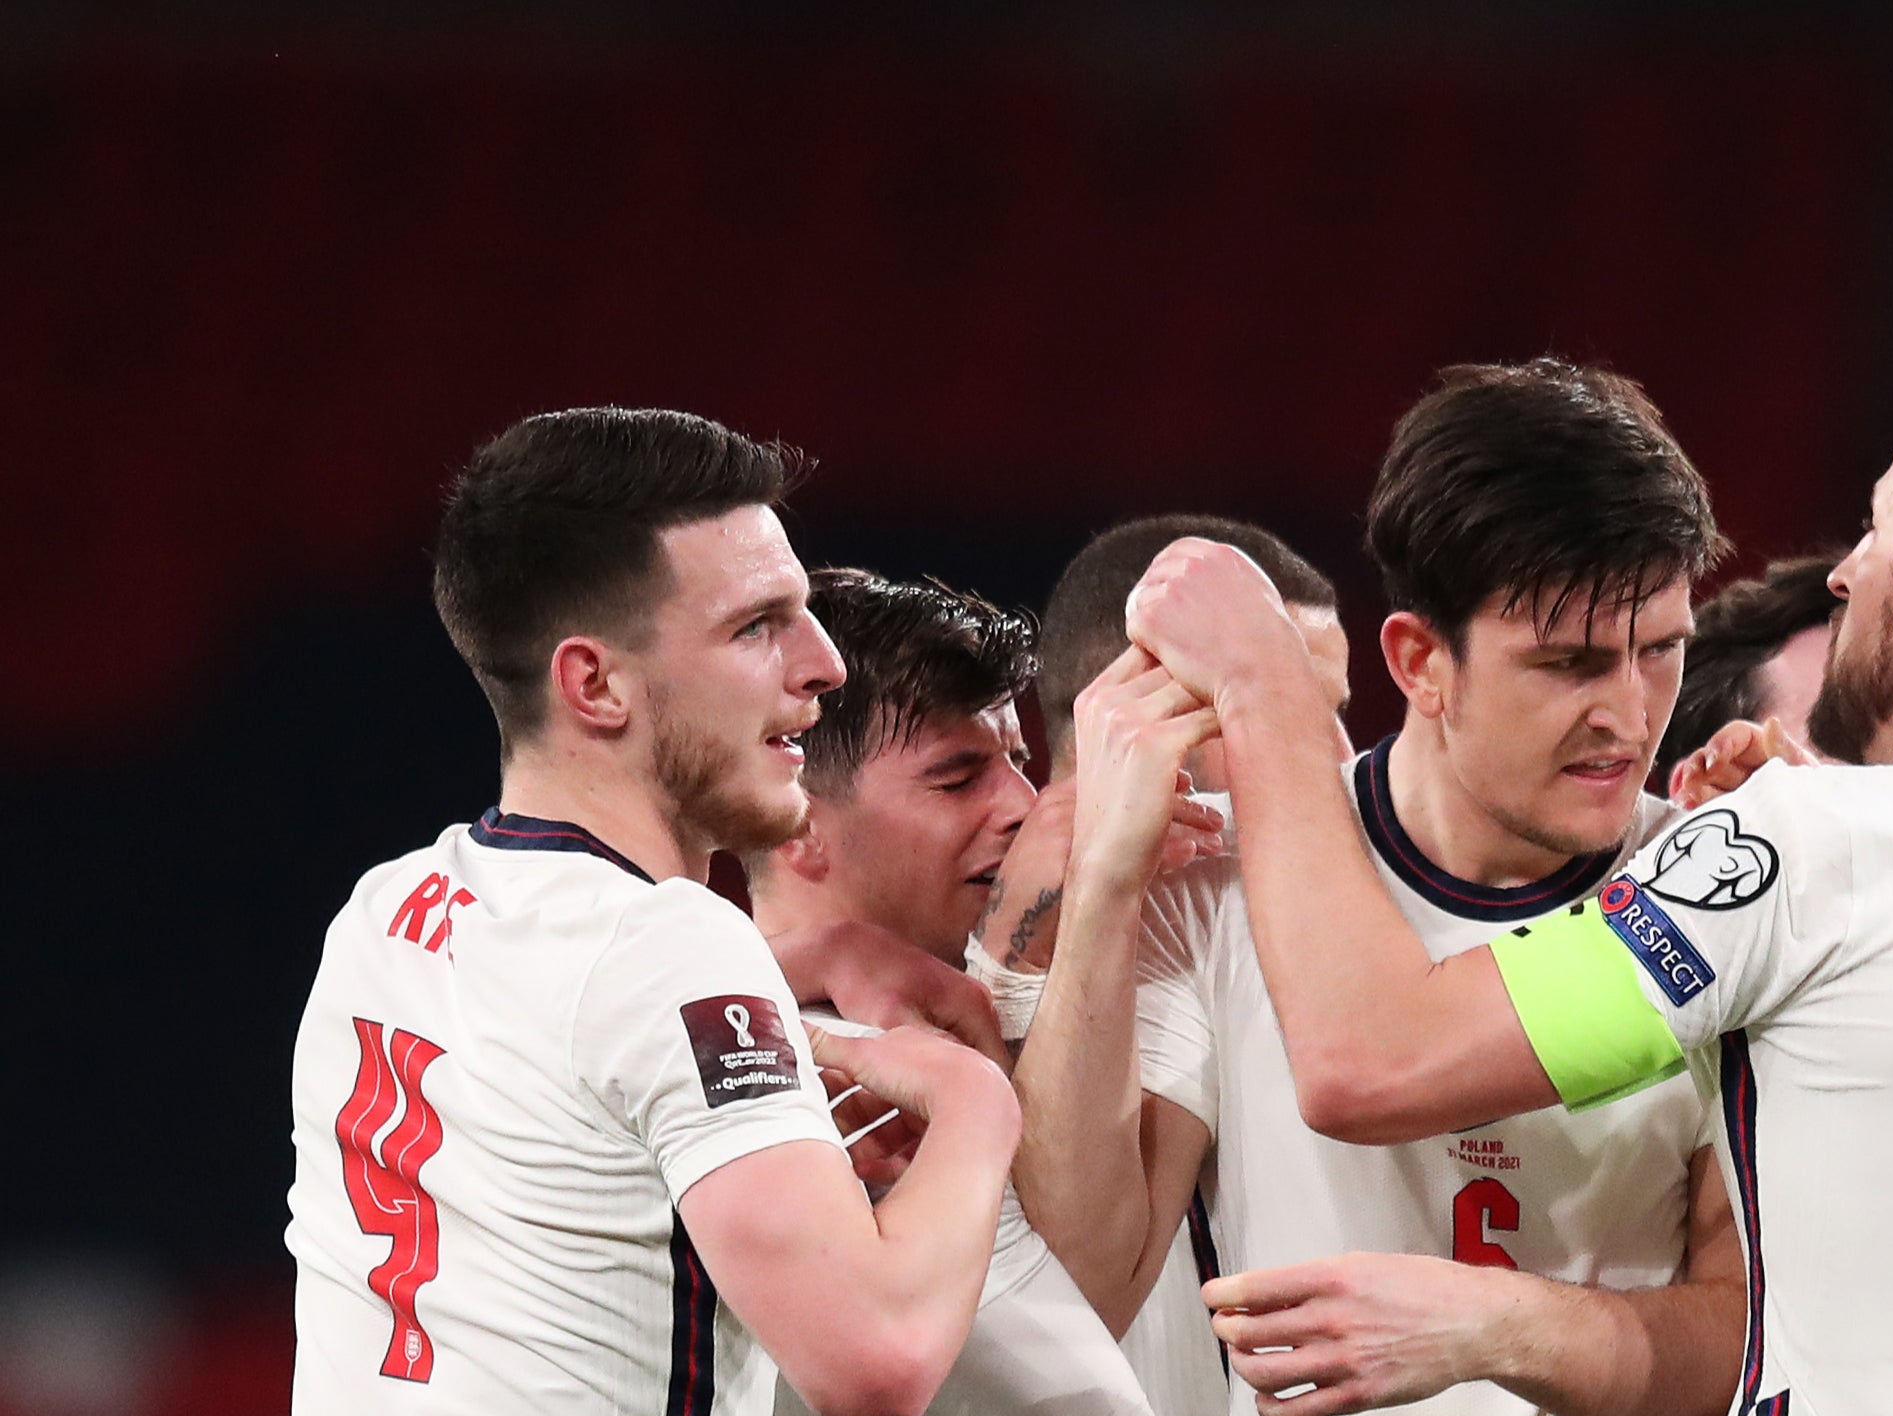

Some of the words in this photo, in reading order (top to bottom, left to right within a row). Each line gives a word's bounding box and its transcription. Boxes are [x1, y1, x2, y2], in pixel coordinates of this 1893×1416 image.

[1621, 903, 1704, 994] RESPECT
[722, 1071, 787, 1090] Qualifiers
[1460, 1139, 1504, 1154] POLAND
[1458, 1152, 1496, 1169] MARCH
[1498, 1156, 1520, 1170] 2021
[333, 1016, 448, 1384] 4
